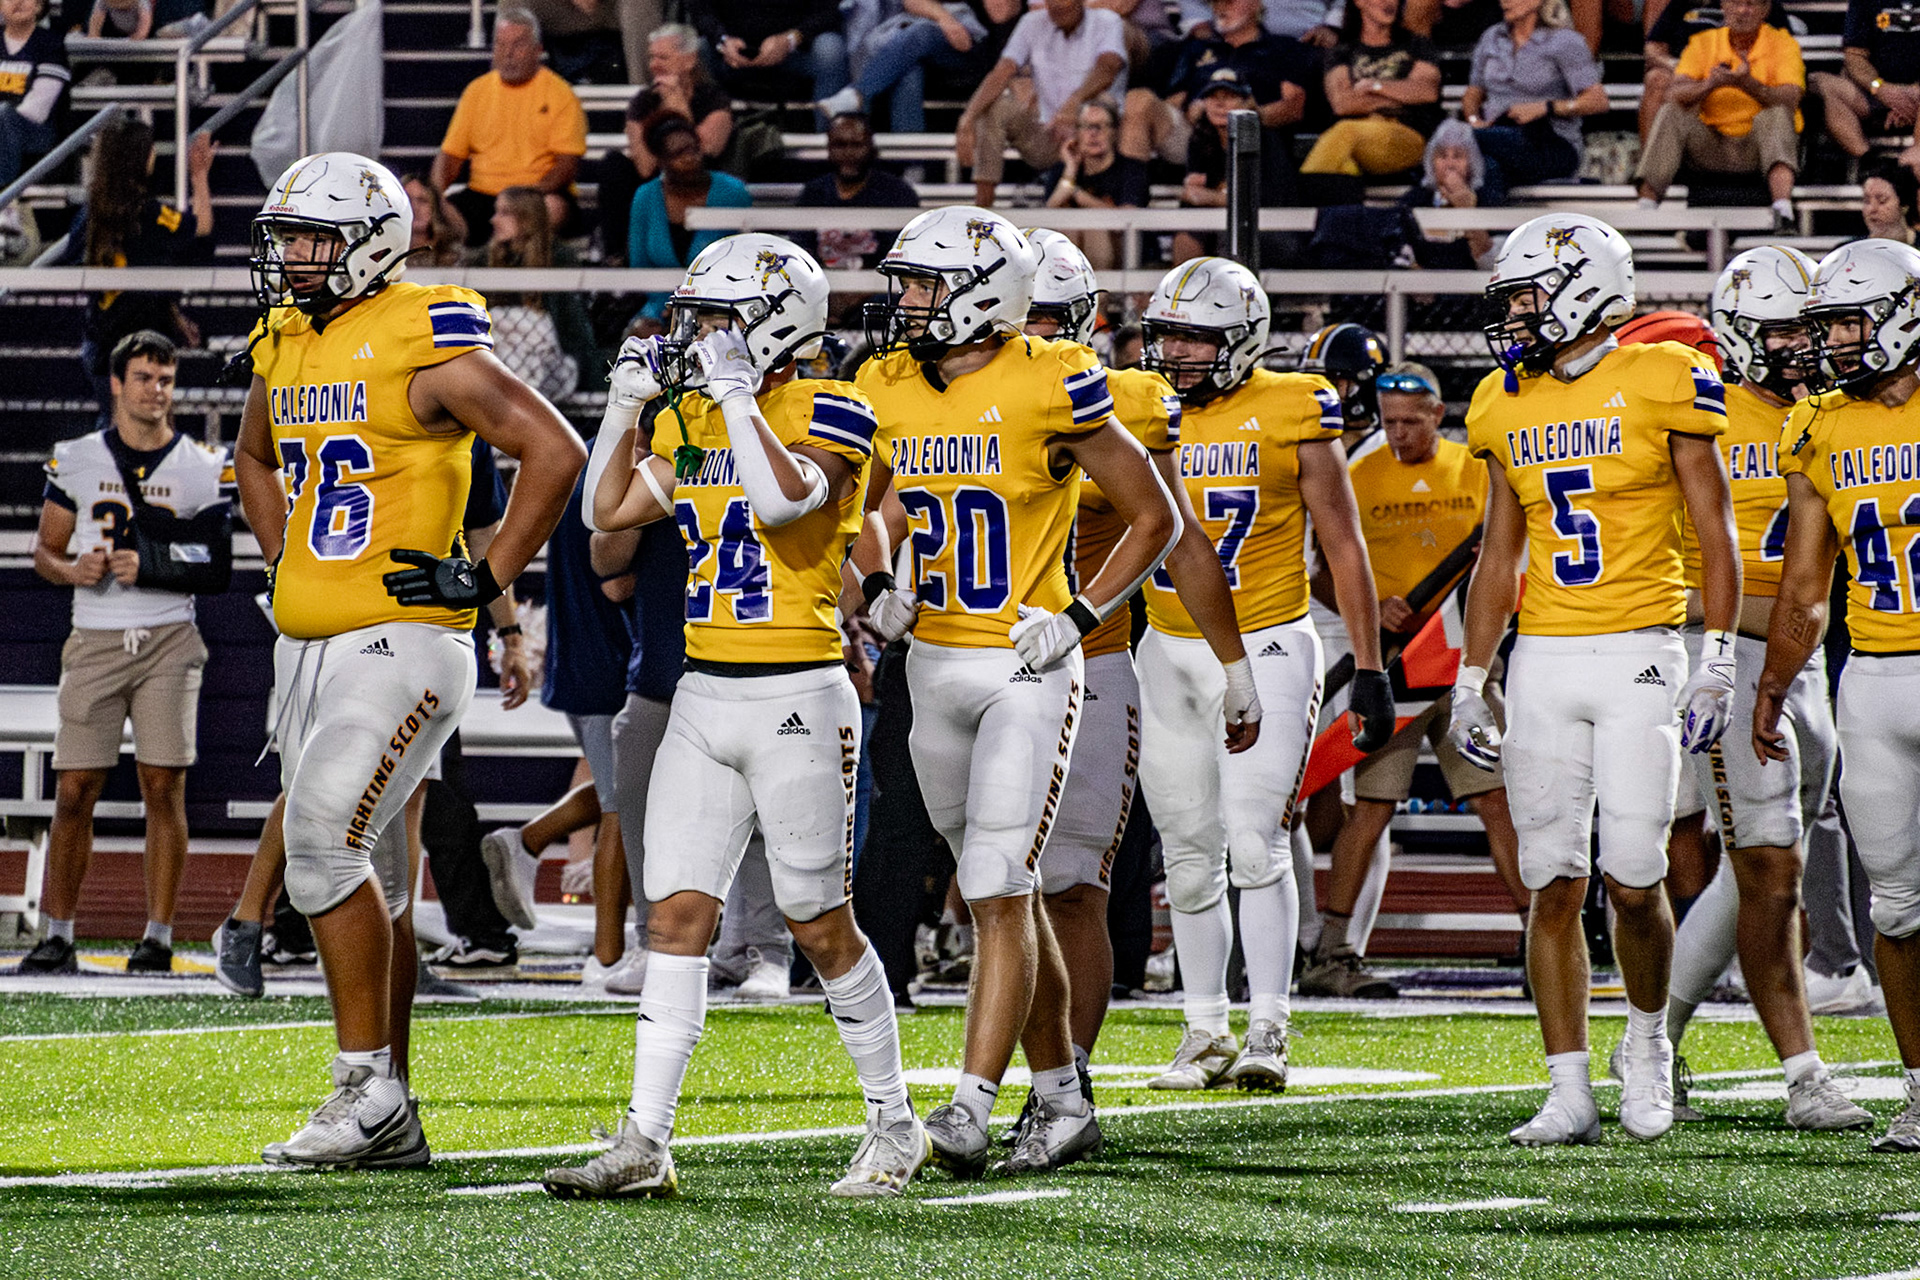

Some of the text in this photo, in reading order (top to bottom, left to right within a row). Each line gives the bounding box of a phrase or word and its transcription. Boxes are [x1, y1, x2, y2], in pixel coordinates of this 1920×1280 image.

[271, 380, 368, 426] CALEDONIA
[891, 434, 1002, 476] CALEDONIA
[1179, 441, 1260, 478] EDONIA
[1506, 416, 1622, 468] CALEDONIA
[1830, 443, 1920, 491] CALEDO
[99, 482, 170, 497] BUCEERS
[278, 434, 375, 560] 76
[1370, 495, 1476, 520] CALEDONIA
[92, 499, 178, 554] 3
[897, 485, 1012, 614] 20
[1542, 463, 1604, 587] 5
[674, 495, 773, 623] 24
[359, 647, 395, 658] adidas
[1009, 673, 1042, 684] adidas
[1634, 676, 1666, 687] adidas
[777, 726, 811, 736] adidas
[345, 687, 440, 850] FIGHTING SCOTS
[1025, 678, 1080, 873] FIGHTING SCOTS
[838, 726, 855, 898] GHTING SCOTS
[1098, 703, 1139, 886] FIGHTING SCOTS
